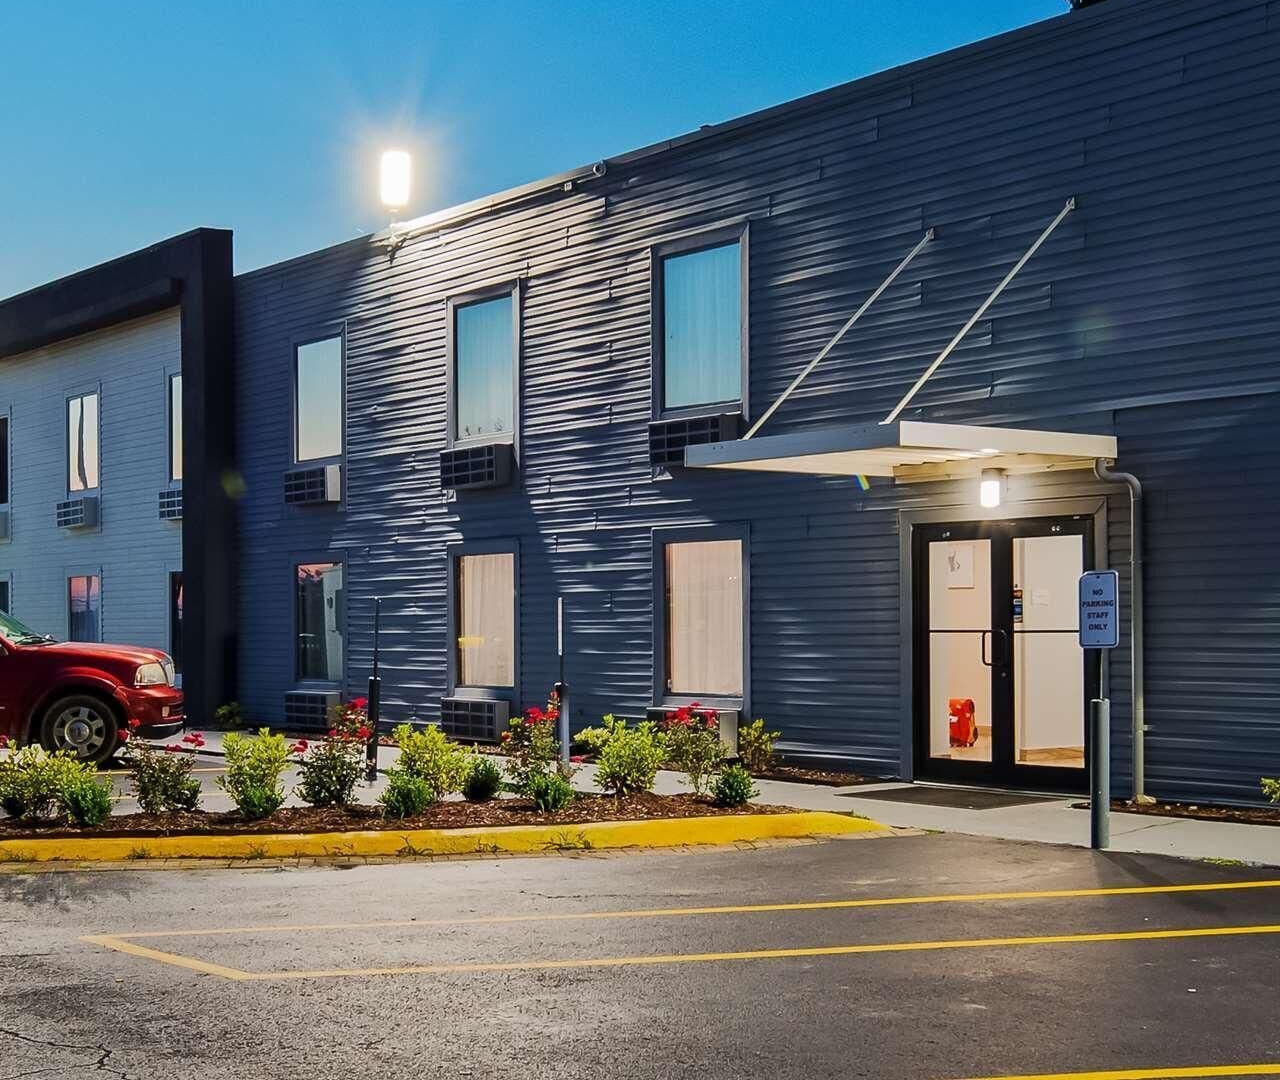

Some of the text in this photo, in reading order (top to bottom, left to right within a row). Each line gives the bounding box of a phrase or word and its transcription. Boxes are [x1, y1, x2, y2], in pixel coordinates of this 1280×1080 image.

[1092, 588, 1104, 596] NO
[1081, 599, 1114, 608] PARKING
[1086, 611, 1109, 620] STAFF
[1088, 623, 1108, 631] ONLY
